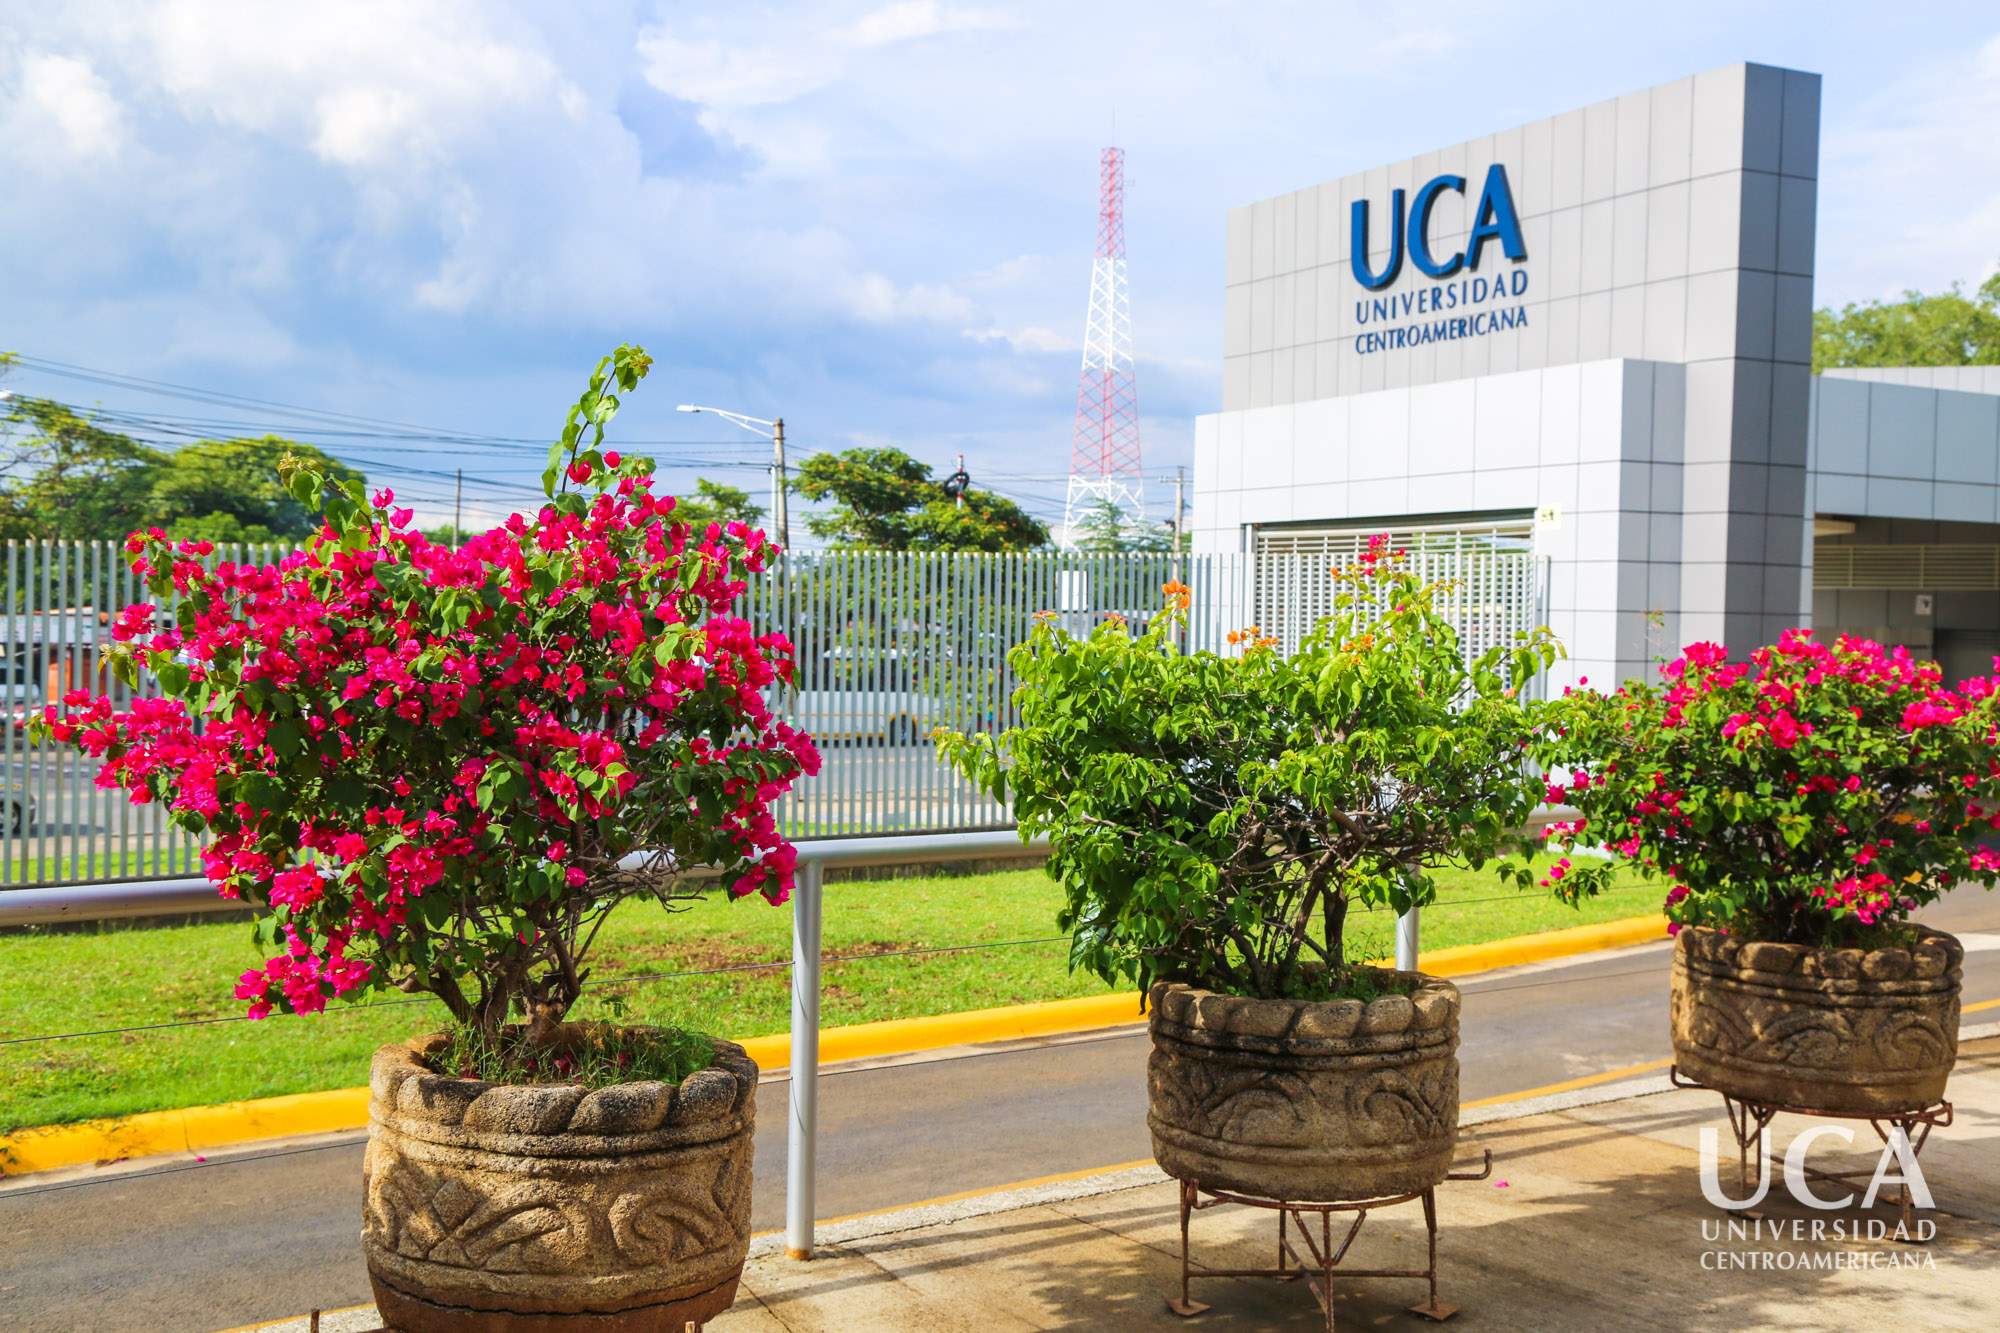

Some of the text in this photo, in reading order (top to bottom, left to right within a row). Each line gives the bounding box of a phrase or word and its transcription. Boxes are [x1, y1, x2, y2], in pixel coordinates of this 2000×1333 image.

[1351, 164, 1528, 292] UCA
[1356, 269, 1528, 325] UNIVERSIDAD
[1355, 306, 1528, 355] CENTROAMERICANA
